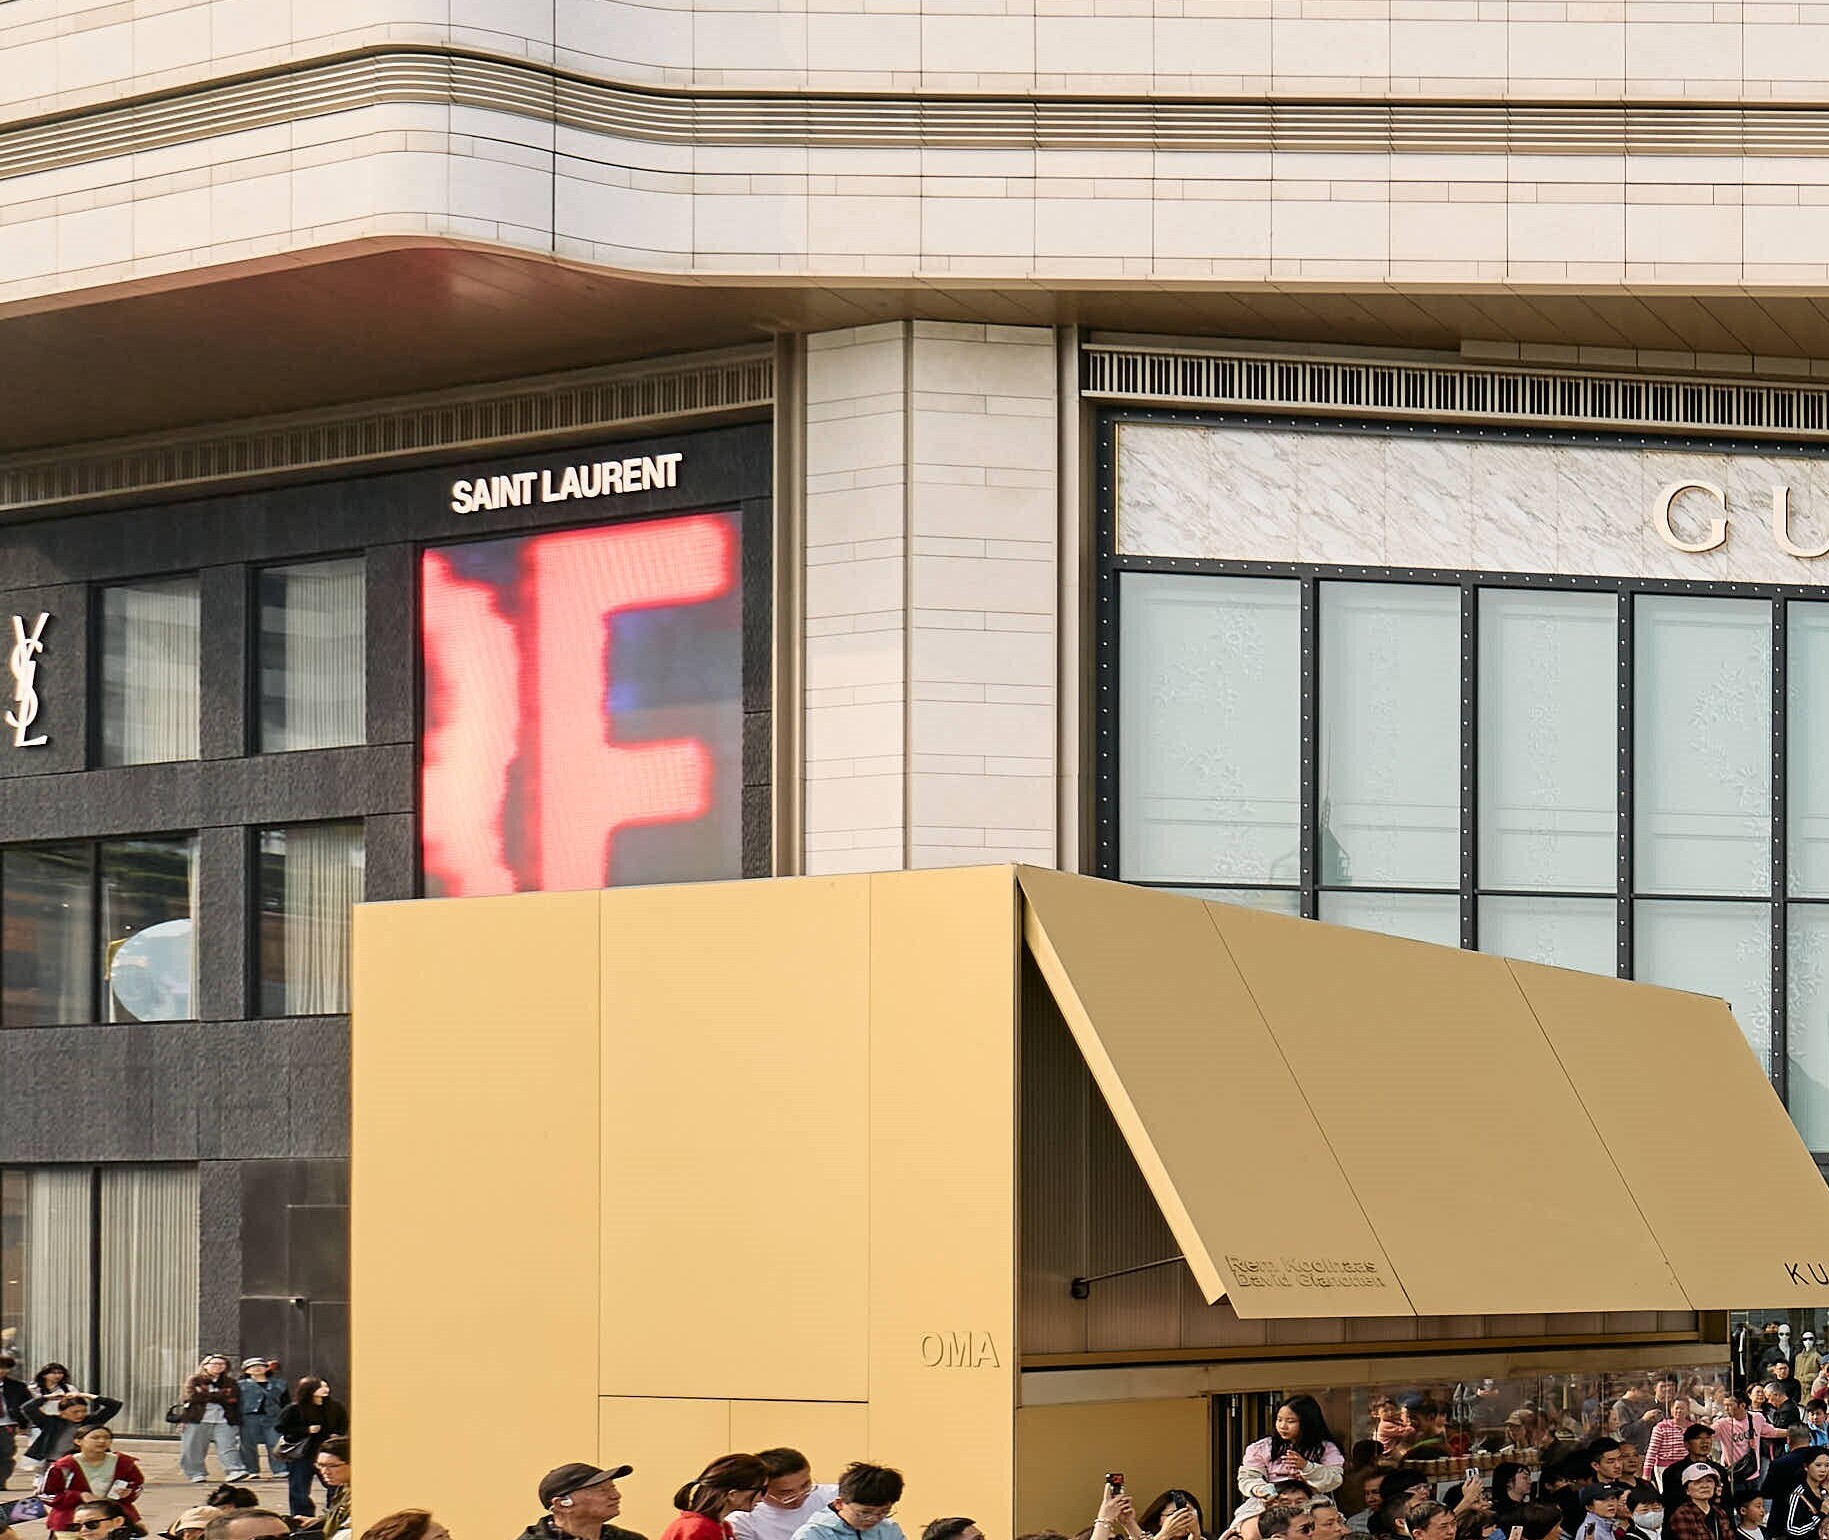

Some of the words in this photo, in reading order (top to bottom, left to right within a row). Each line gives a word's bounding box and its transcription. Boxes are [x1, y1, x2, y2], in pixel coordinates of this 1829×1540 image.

[451, 469, 538, 515] SAINT
[540, 452, 684, 504] LAURENT
[919, 1330, 1000, 1369] OMA
